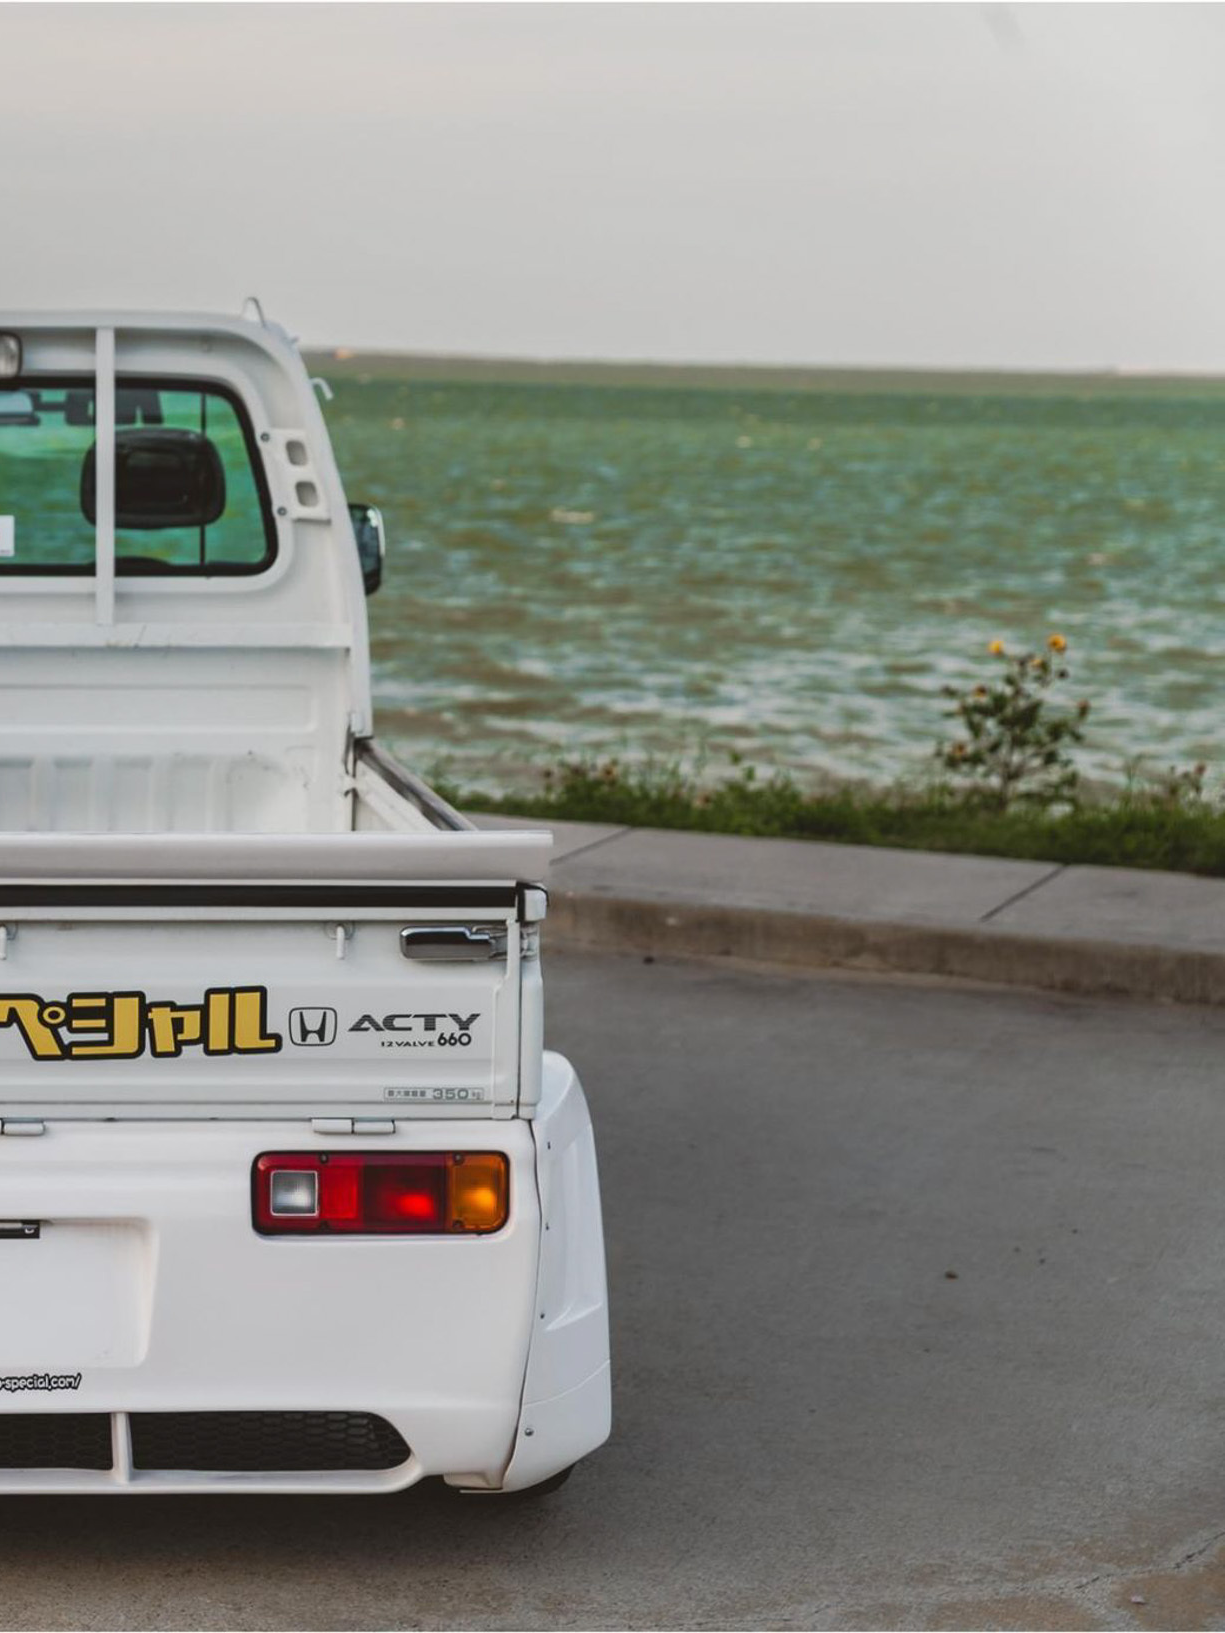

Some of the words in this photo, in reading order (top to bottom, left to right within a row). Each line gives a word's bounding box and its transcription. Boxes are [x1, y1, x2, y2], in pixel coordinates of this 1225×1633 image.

[348, 1013, 481, 1032] ACTY
[437, 1033, 472, 1047] 660
[433, 1088, 469, 1100] 350
